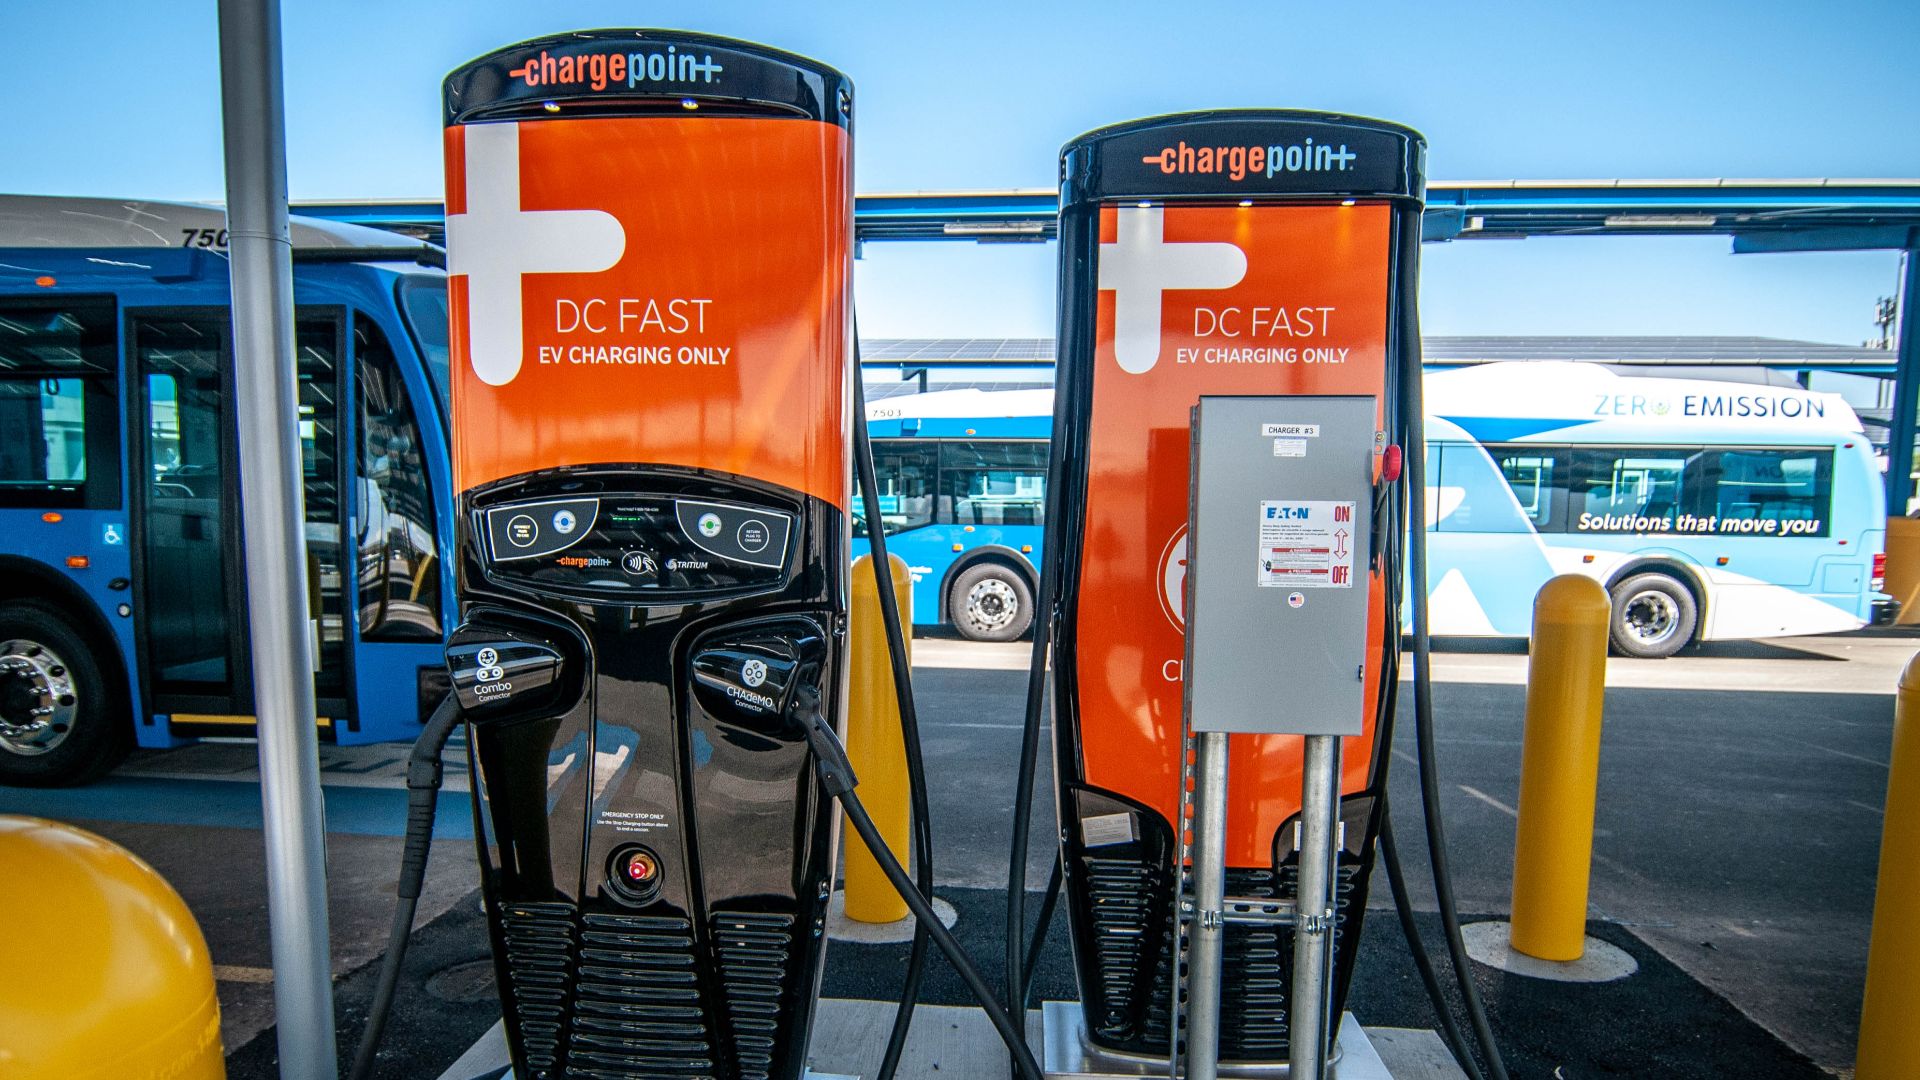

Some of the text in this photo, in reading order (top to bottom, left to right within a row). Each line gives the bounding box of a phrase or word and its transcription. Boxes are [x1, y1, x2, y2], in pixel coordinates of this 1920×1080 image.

[556, 299, 713, 333] DC FAST
[1194, 307, 1335, 337] DC FAST
[539, 346, 731, 365] EV CHARGING ONLY
[1176, 348, 1349, 364] EV CHARGING ONLY
[873, 408, 902, 417] 7503
[1683, 395, 1825, 418] EMISSION
[1268, 426, 1301, 434] CHARGER
[1334, 505, 1350, 522] ON
[1578, 513, 1819, 537] Solutions that move you
[677, 561, 709, 570] TRITIUM
[1331, 566, 1349, 584] OFF
[474, 681, 512, 695] Combo
[478, 691, 511, 702] Connector
[726, 686, 773, 708] CHAdeMO
[734, 699, 763, 713] Connector
[601, 811, 634, 819] EMERGENCY
